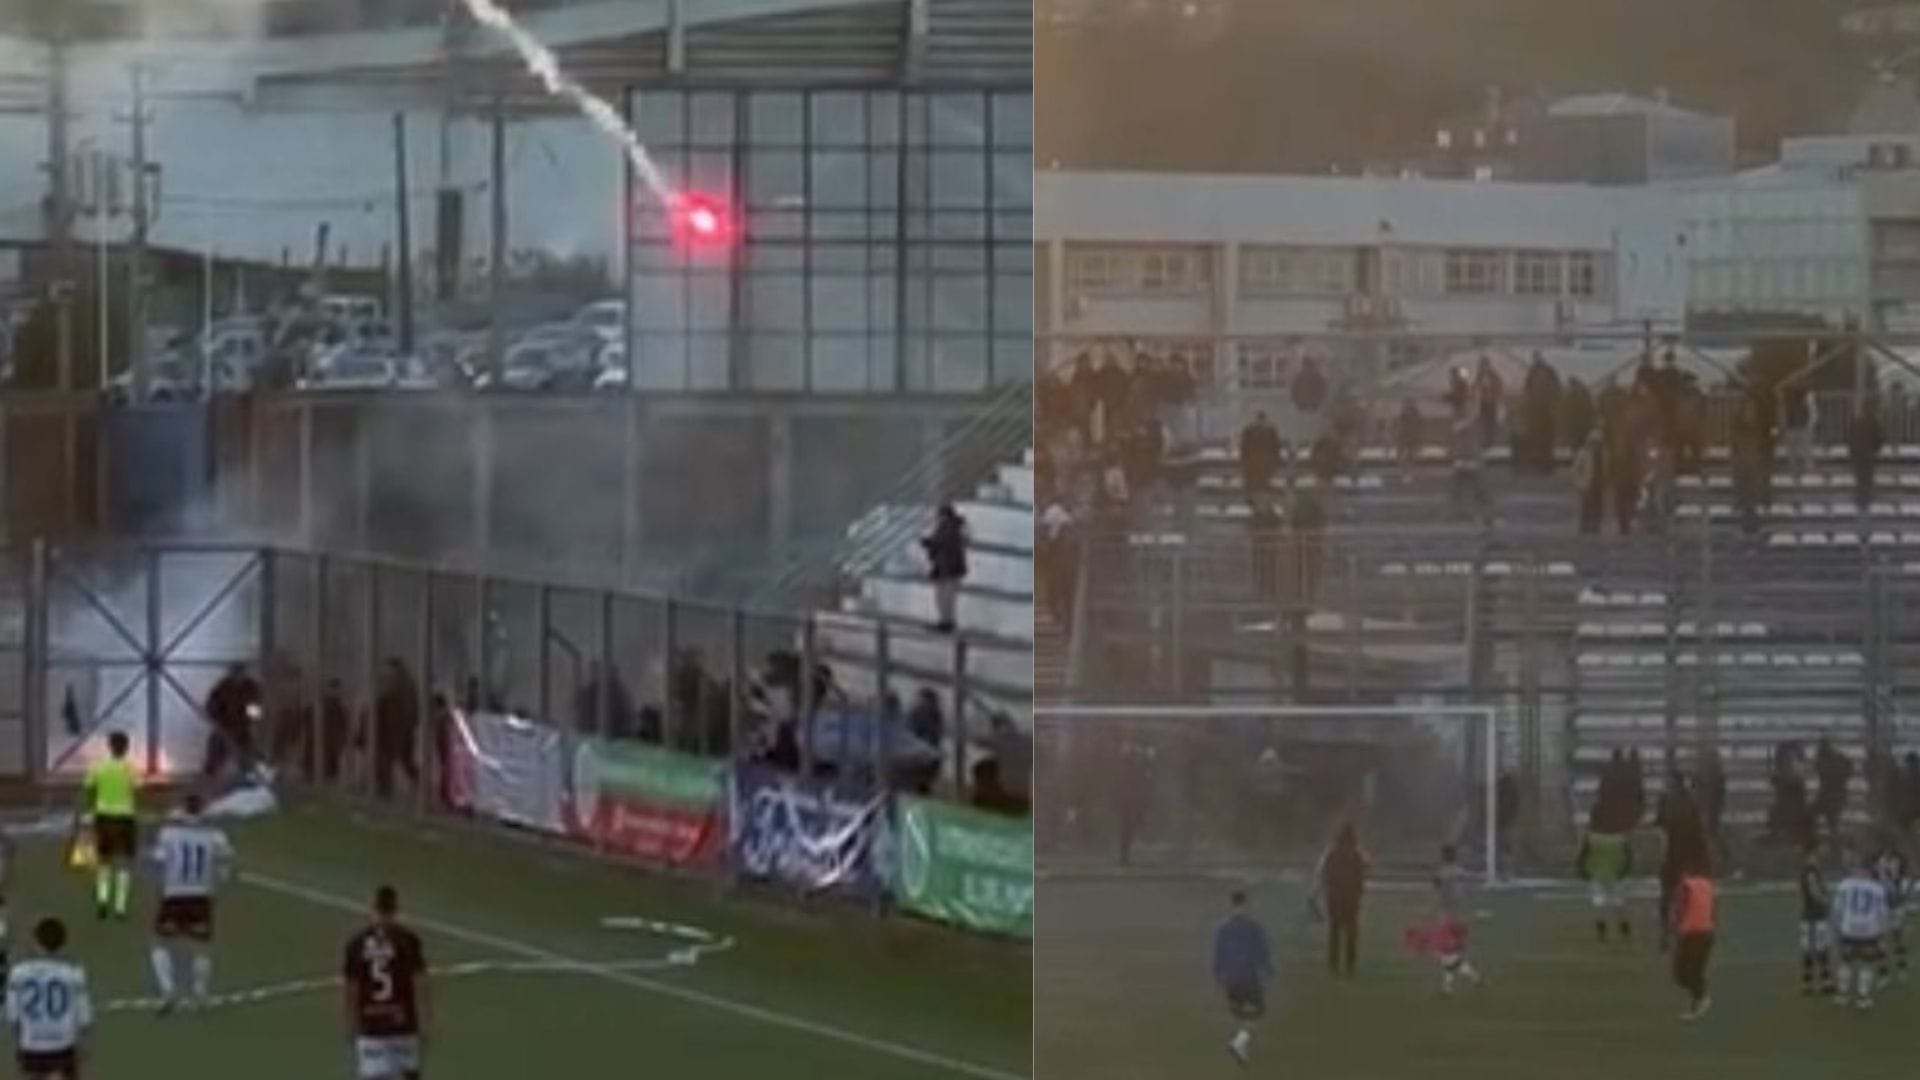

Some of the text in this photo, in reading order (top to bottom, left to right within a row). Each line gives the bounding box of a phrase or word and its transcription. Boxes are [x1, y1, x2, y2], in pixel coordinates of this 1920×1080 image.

[180, 840, 207, 883] 11
[22, 976, 69, 1019] 20
[370, 957, 395, 1001] 5
